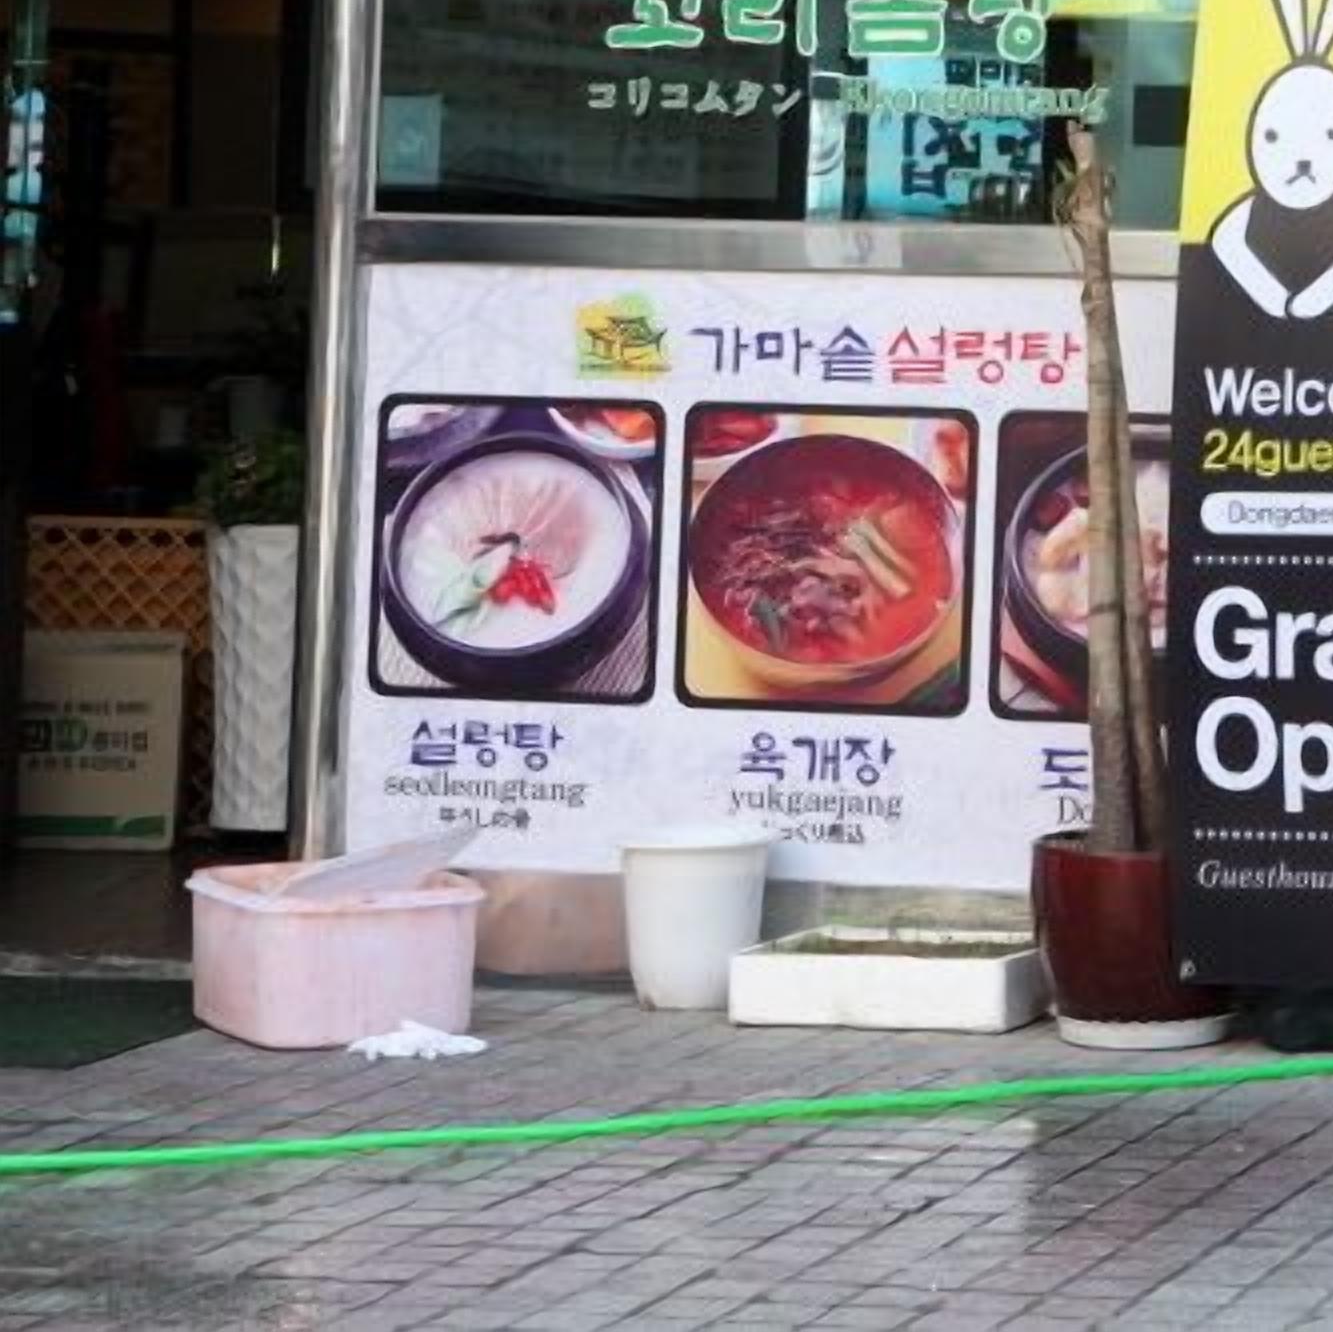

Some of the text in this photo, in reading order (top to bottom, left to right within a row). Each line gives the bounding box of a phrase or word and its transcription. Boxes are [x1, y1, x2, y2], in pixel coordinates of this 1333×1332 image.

[411, 720, 565, 772] 설렁탕
[739, 731, 897, 788] 육개장
[730, 784, 903, 819] yukgaejang
